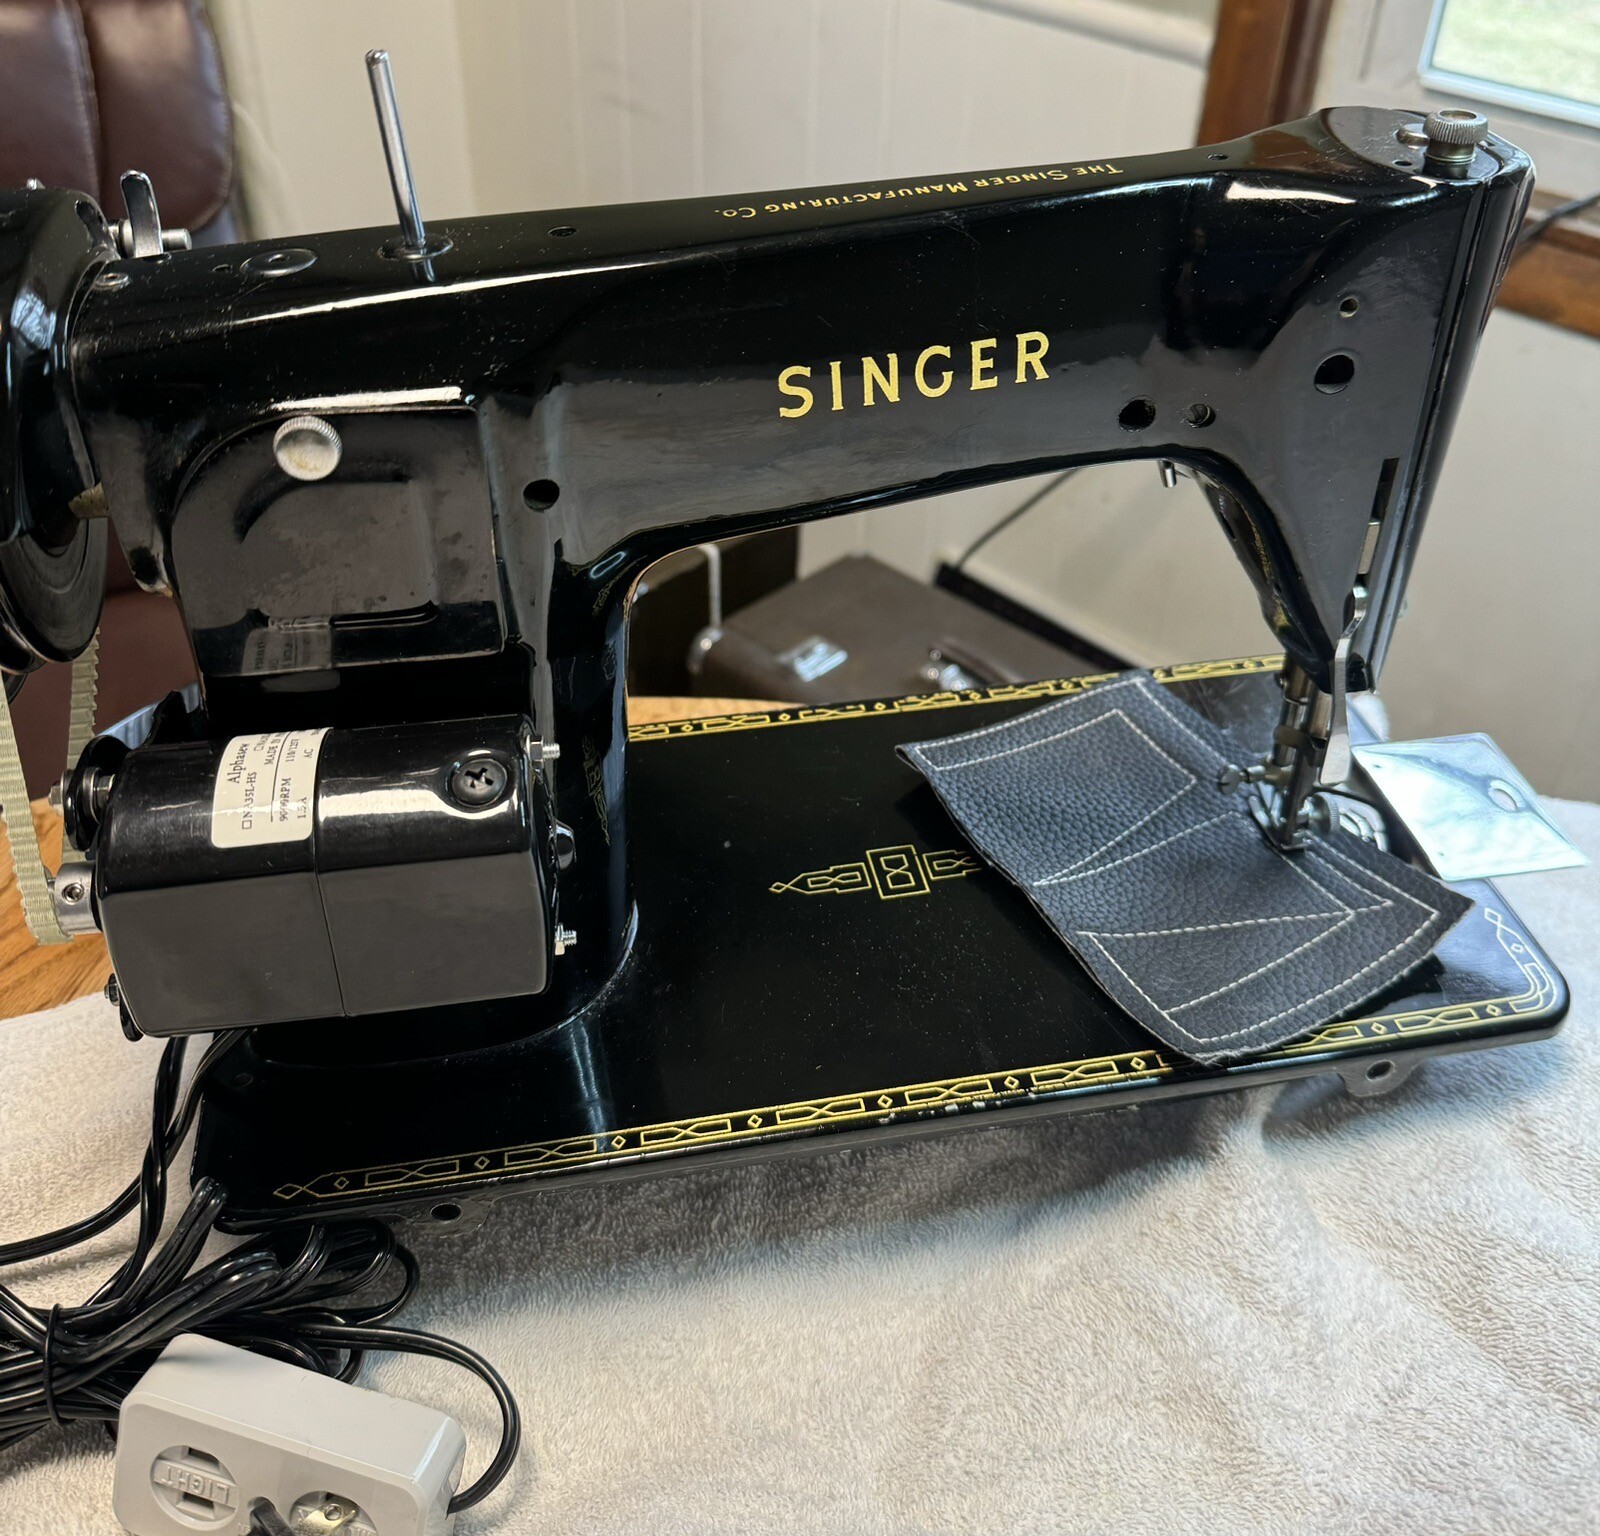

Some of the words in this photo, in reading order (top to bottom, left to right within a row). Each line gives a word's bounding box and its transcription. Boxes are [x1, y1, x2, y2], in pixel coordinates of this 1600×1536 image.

[973, 169, 1068, 188] SINGER
[1072, 163, 1124, 176] THE
[778, 331, 1050, 418] SINGER
[227, 743, 250, 784] Alphasew
[264, 745, 278, 765] MADE
[304, 748, 313, 759] AC
[161, 1464, 229, 1504] LIGHT
